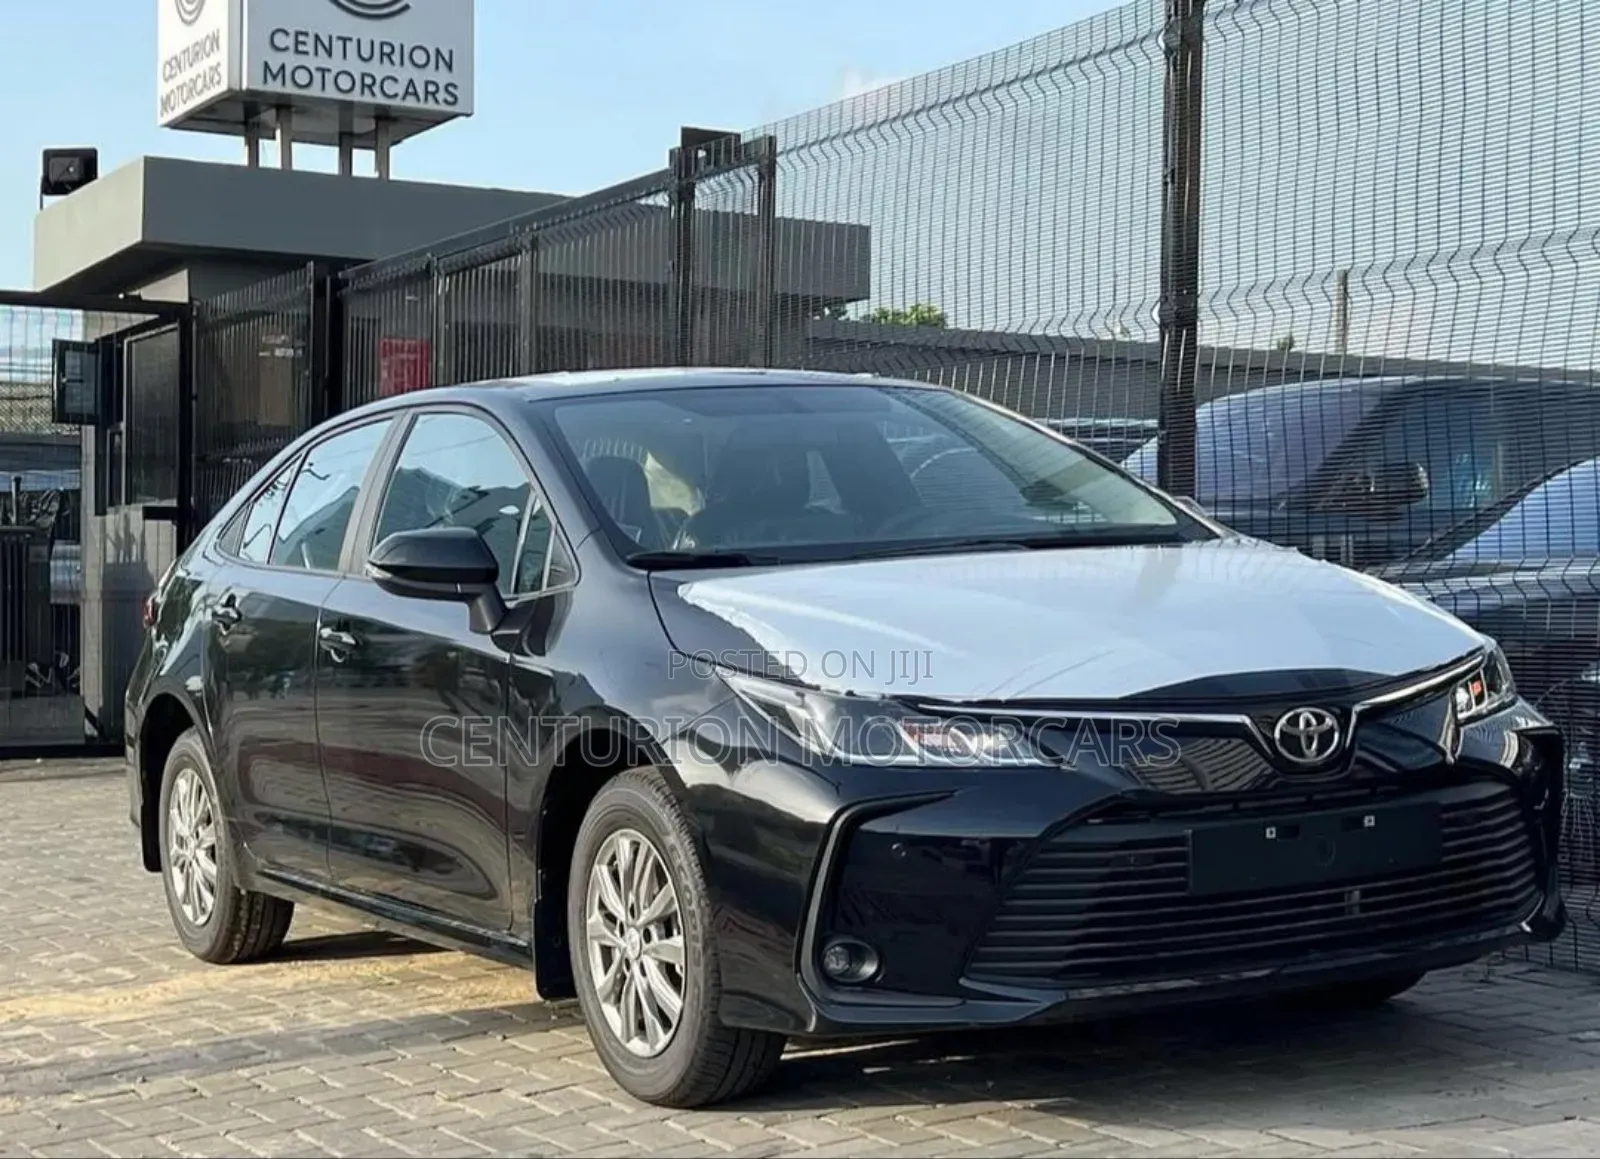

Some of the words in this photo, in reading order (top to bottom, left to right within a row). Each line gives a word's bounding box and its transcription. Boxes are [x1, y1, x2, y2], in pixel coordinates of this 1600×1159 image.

[162, 28, 220, 83] CENTURION
[269, 28, 454, 73] CENTURION
[160, 61, 221, 117] MOTORCARS
[262, 60, 459, 105] MOTORCARS
